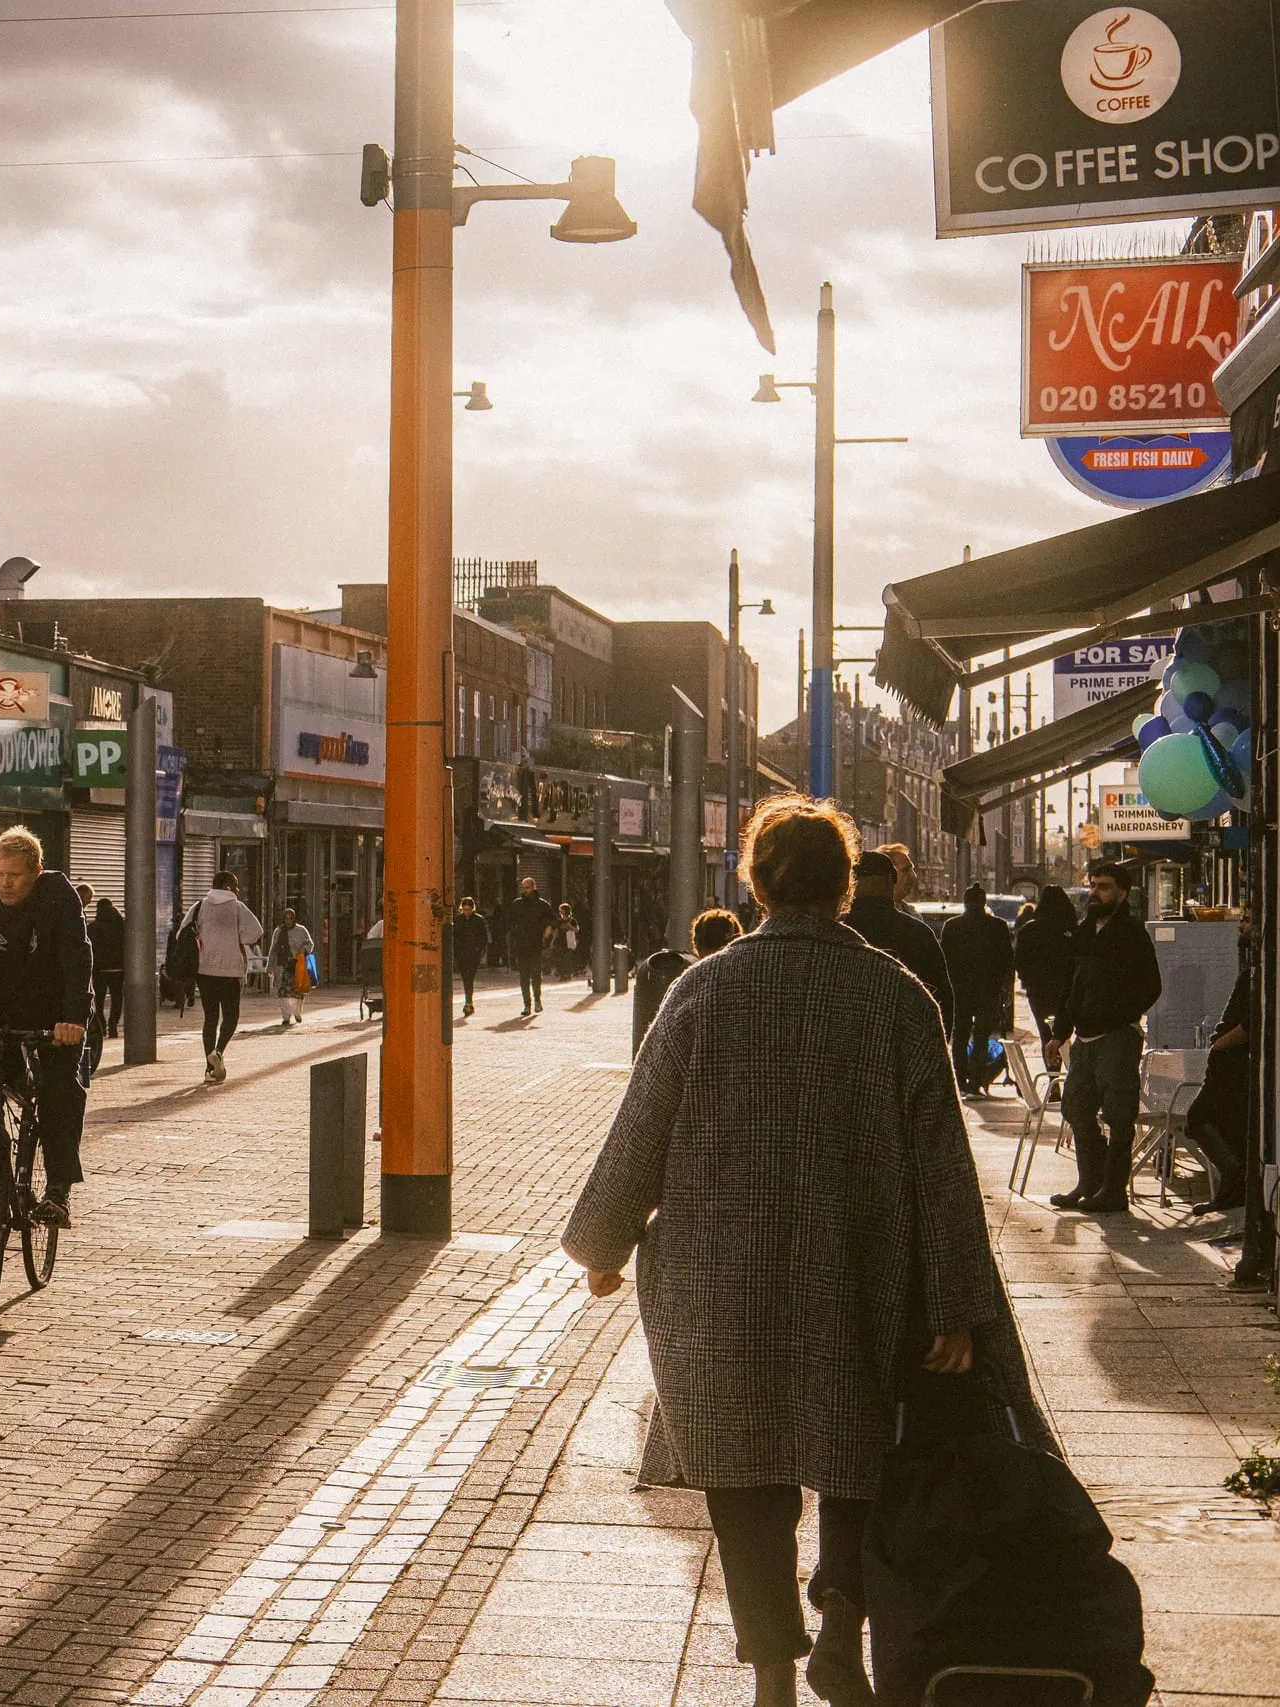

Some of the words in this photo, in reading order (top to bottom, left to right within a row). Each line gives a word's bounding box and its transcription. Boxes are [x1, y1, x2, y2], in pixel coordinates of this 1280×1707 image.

[1096, 95, 1151, 113] COFFEE
[975, 144, 1139, 194] COFFEE
[1154, 133, 1280, 180] SHOP
[1040, 384, 1098, 412] 020
[1108, 382, 1206, 410] 85210
[1093, 451, 1129, 468] FRESH
[1132, 451, 1159, 467] FISH
[1162, 451, 1194, 468] DAILY
[1074, 646, 1120, 665] FOR
[1070, 676, 1114, 688] PRIME
[1119, 676, 1149, 688] FRE
[76, 741, 122, 777] PP
[1107, 822, 1184, 832] HABERDASHERY
